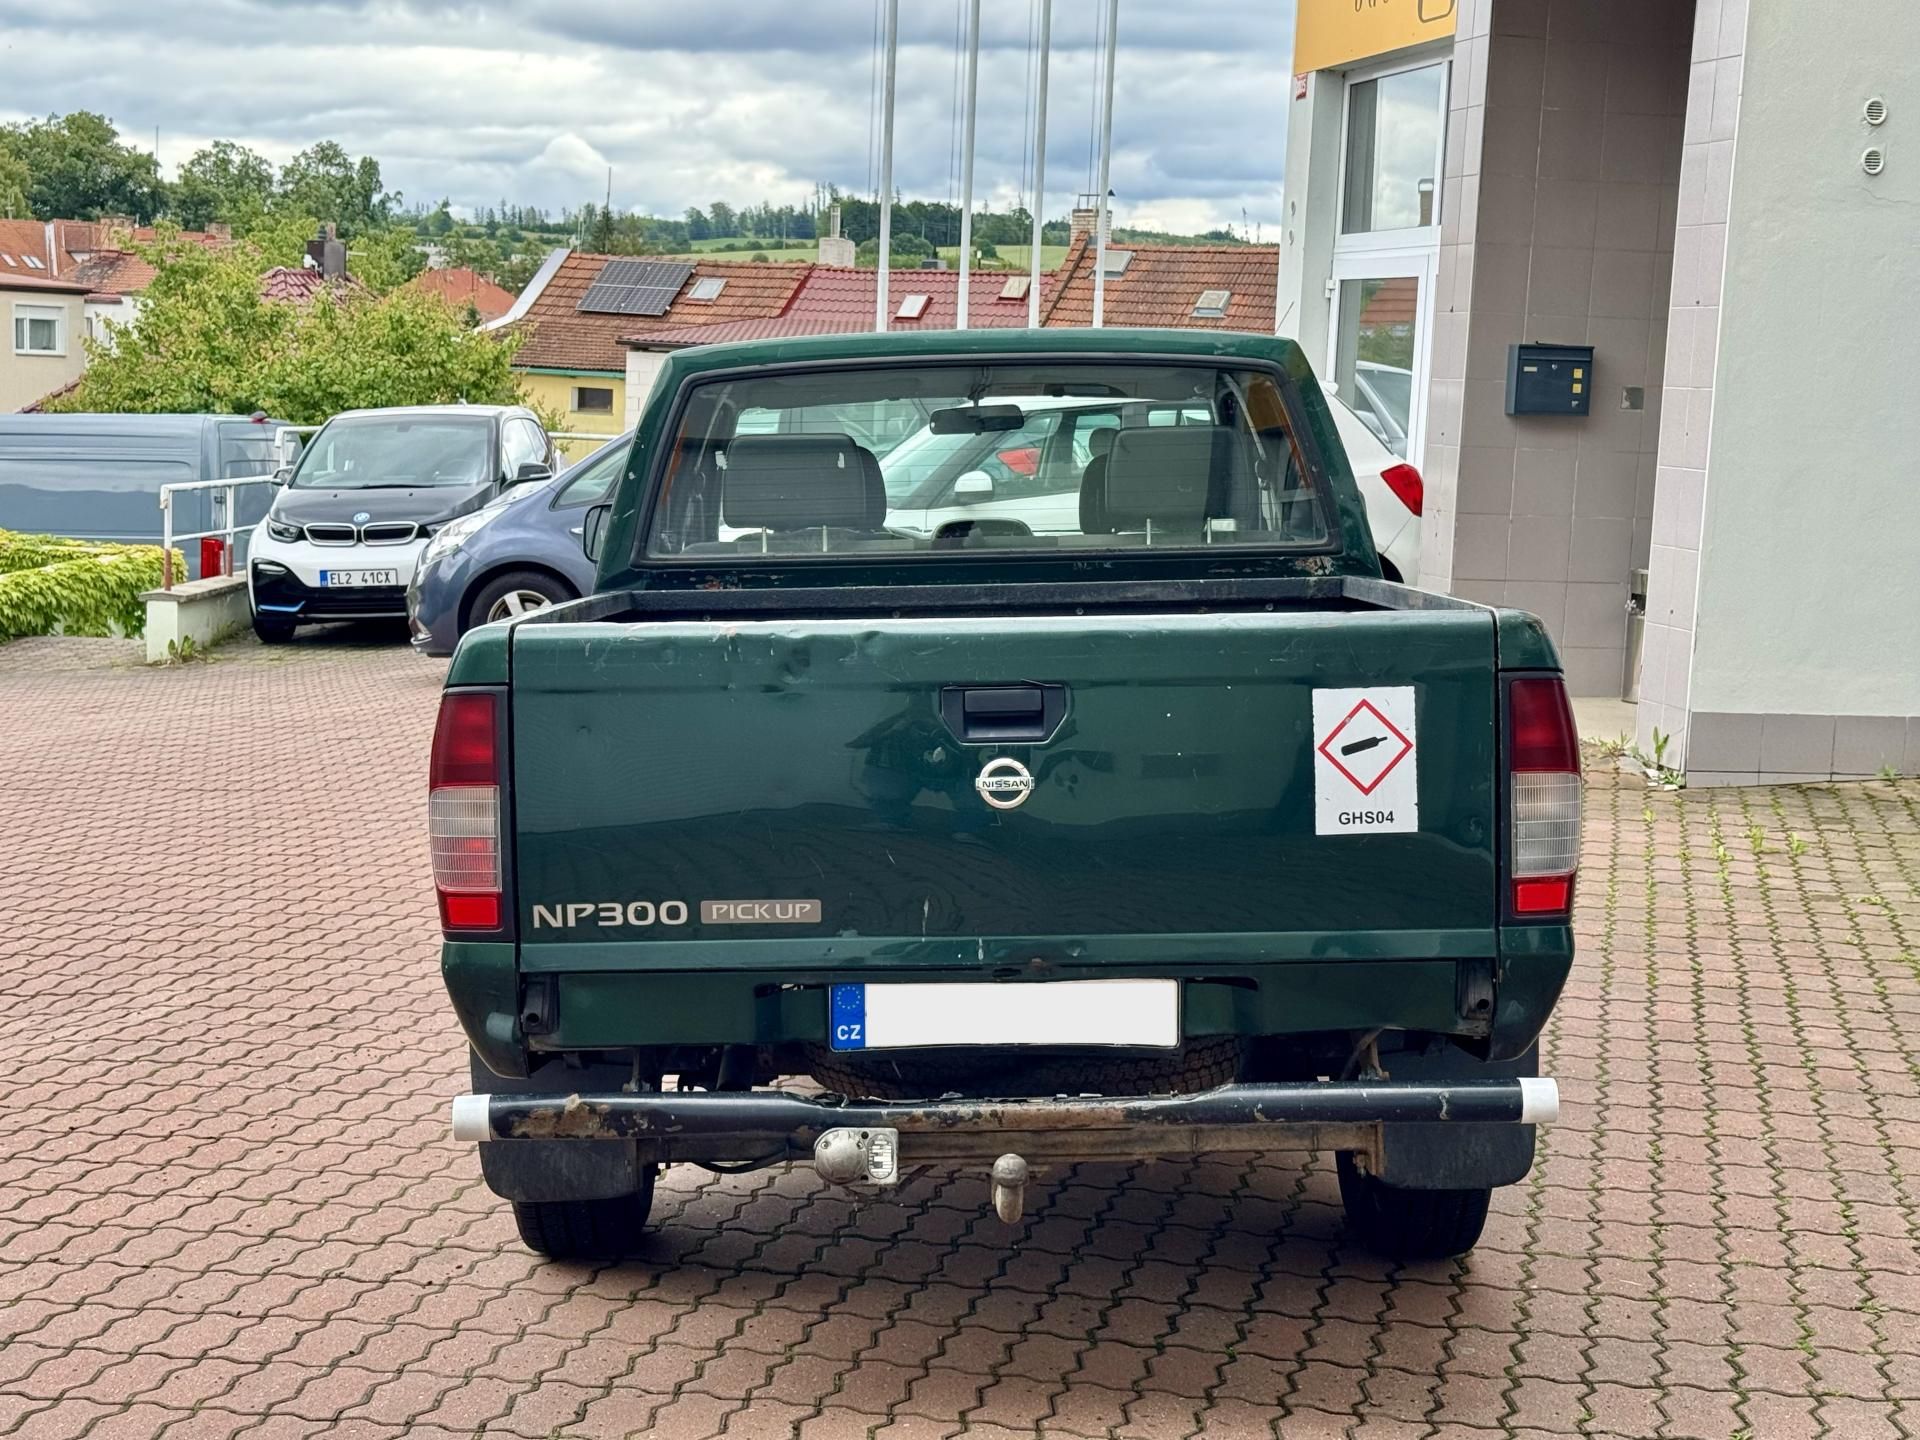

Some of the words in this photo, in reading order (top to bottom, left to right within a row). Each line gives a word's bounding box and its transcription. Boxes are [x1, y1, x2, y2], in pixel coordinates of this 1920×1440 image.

[330, 572, 352, 585] EL2
[361, 571, 391, 584] 41CX
[982, 780, 1028, 788] NISSAN
[1338, 811, 1395, 825] GHS04
[532, 901, 688, 928] NP300
[711, 904, 770, 920] PICK
[776, 904, 812, 919] UP
[837, 1025, 861, 1041] CZ
